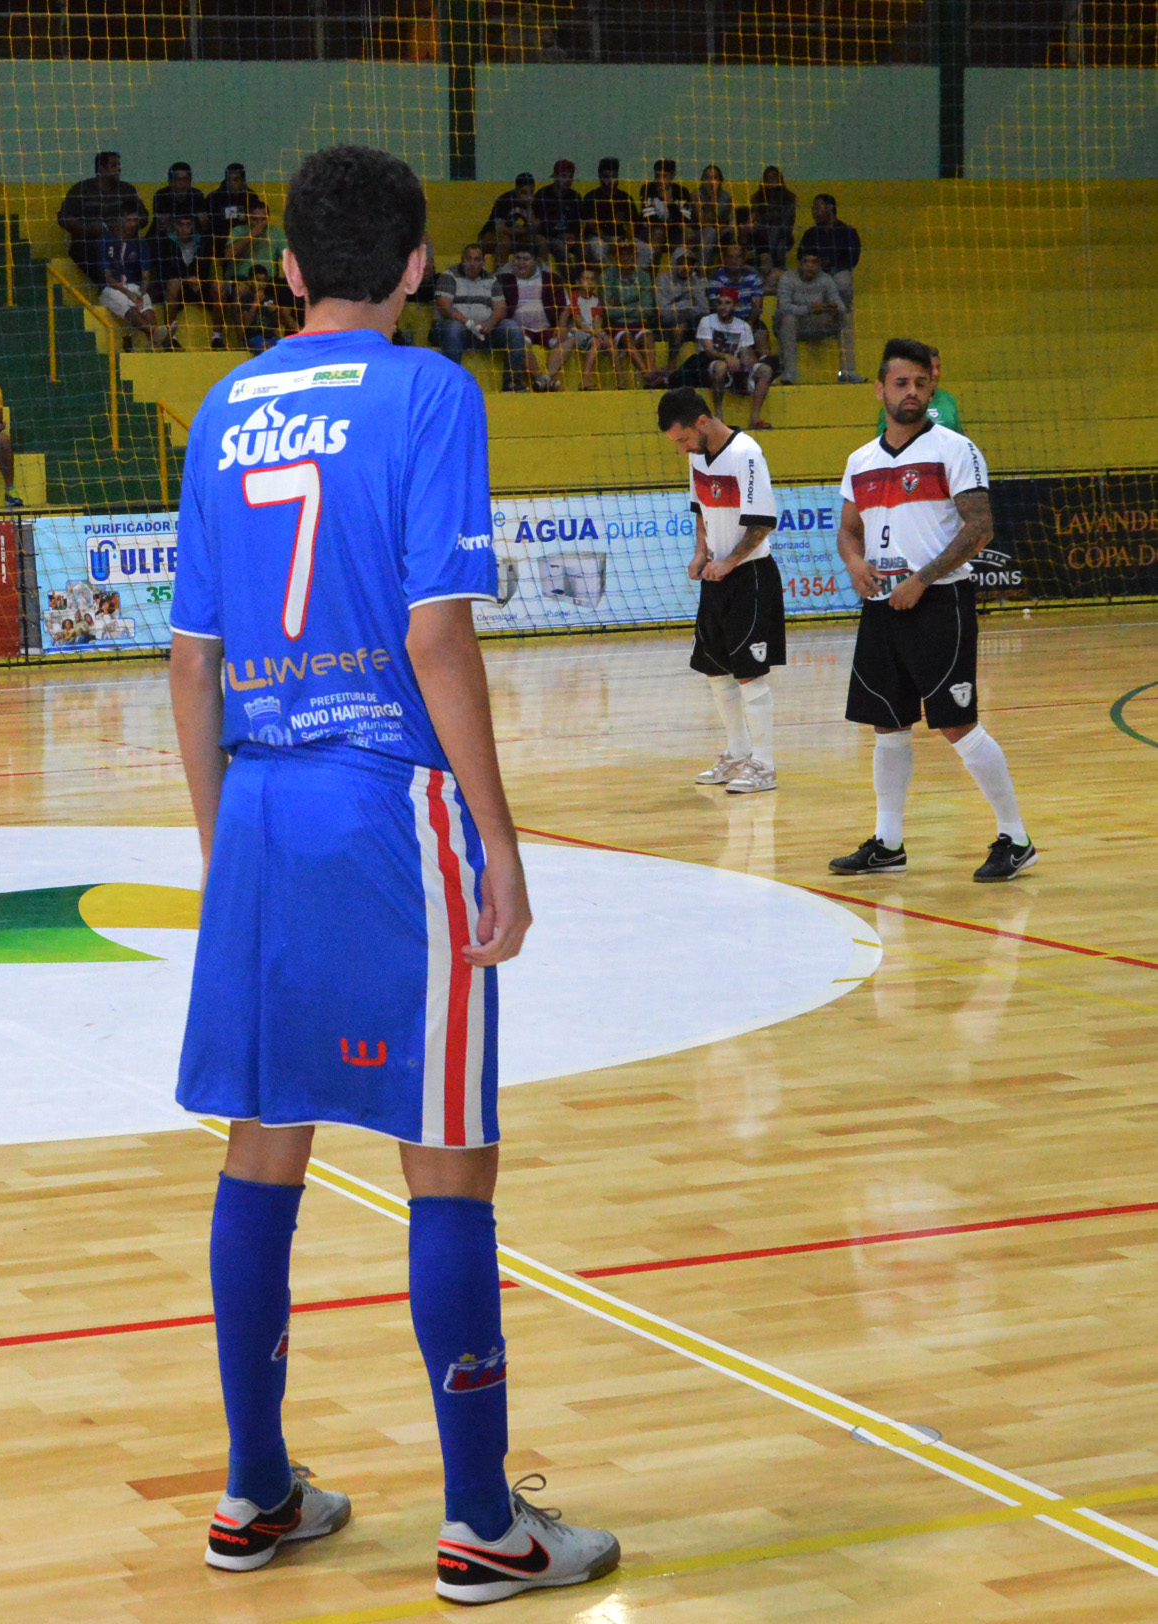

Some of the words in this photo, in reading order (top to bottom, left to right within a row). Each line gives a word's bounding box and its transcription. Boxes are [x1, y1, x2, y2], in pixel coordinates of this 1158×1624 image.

[313, 370, 362, 381] BRASIL
[218, 413, 350, 471] SULGÁS
[84, 521, 171, 535] PURIFICADOR
[515, 515, 599, 543] ÁGUA
[607, 519, 661, 545] pura
[666, 514, 692, 538] de
[880, 526, 890, 548] 9
[243, 459, 322, 641] 7
[1068, 546, 1132, 570] COPA
[1138, 544, 1158, 567] D
[310, 692, 365, 707] PREFEITURA
[366, 692, 378, 702] DE
[290, 709, 330, 730] NOVO
